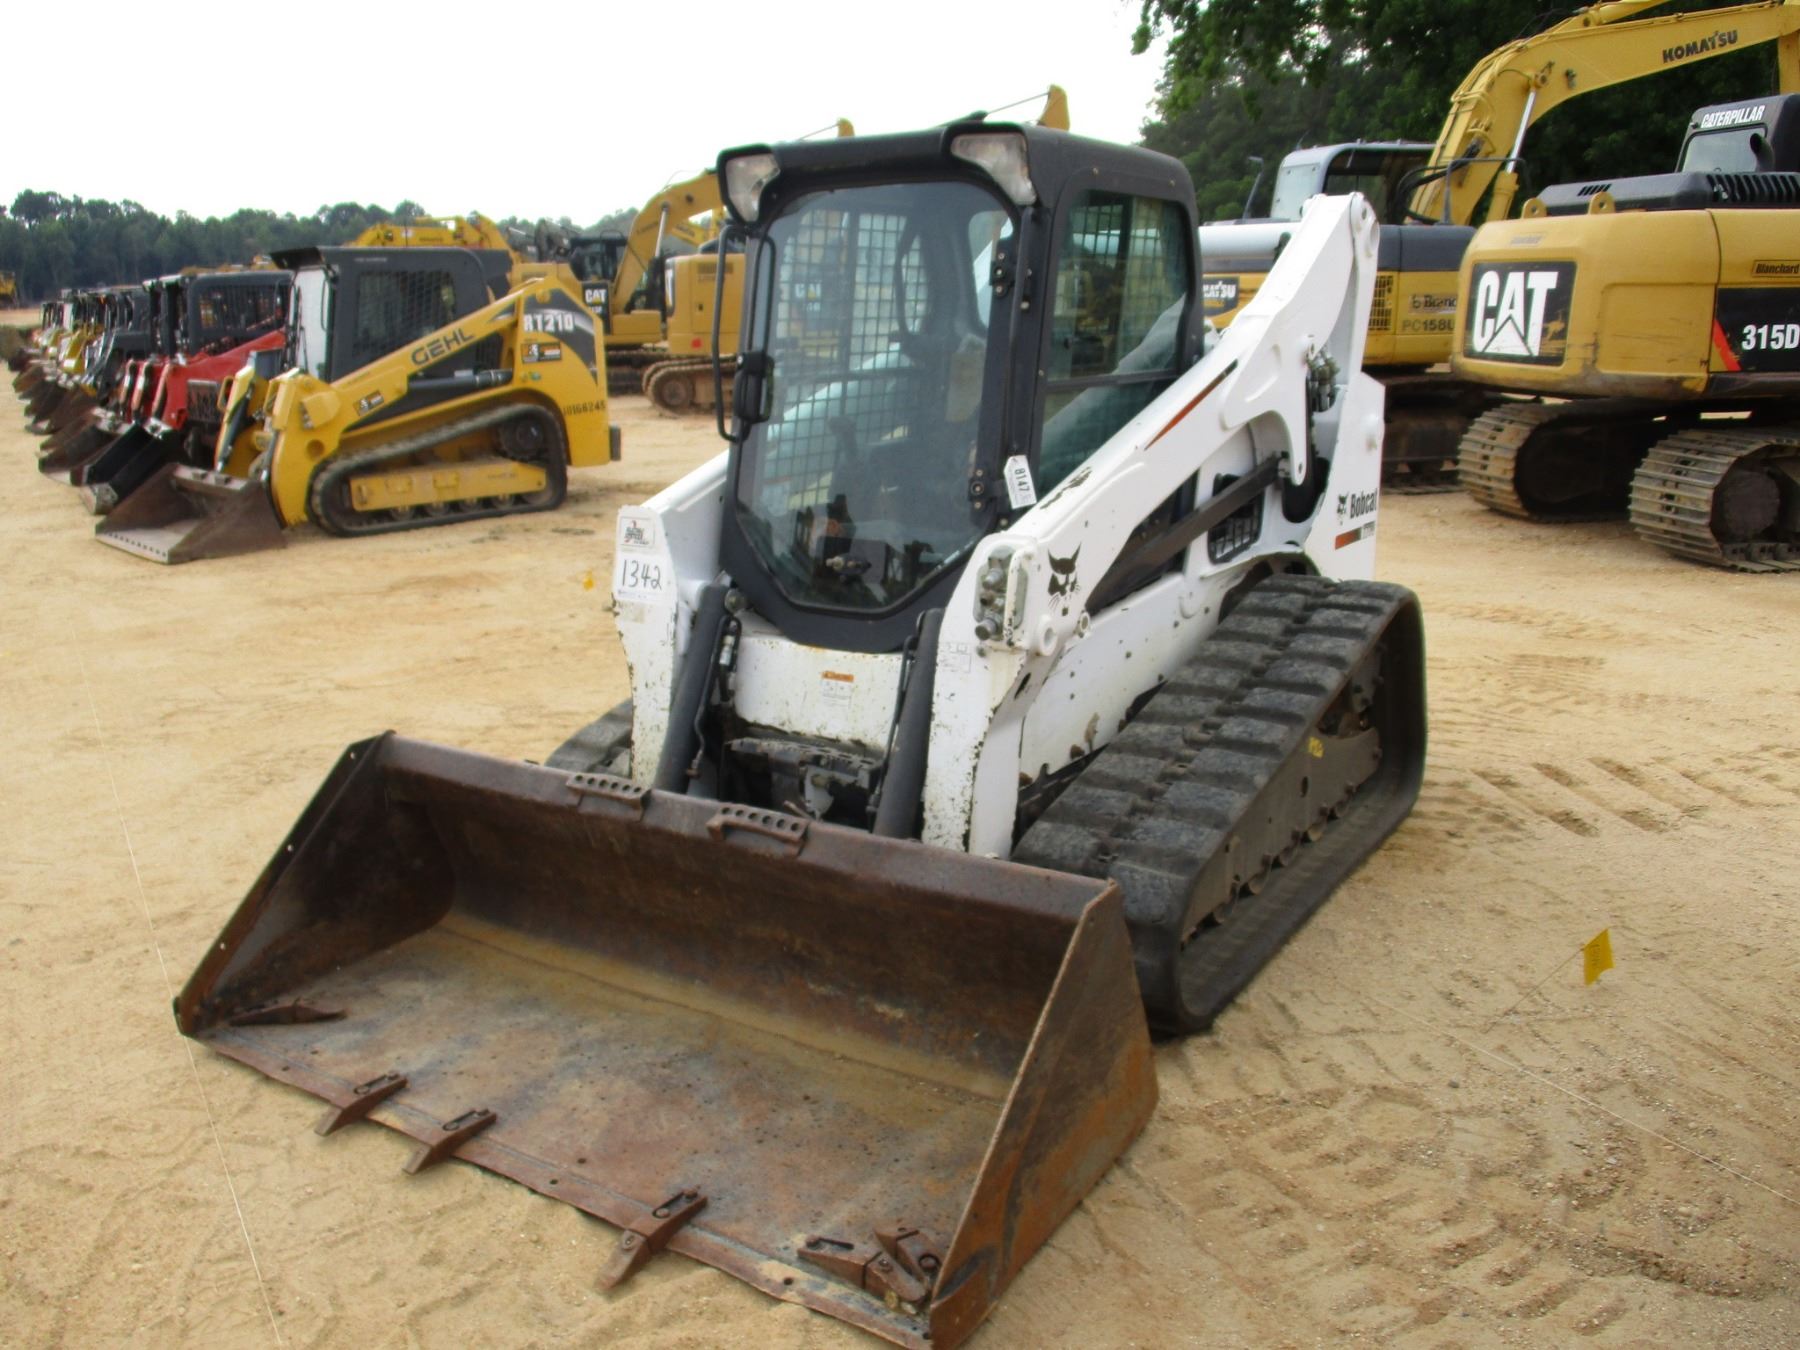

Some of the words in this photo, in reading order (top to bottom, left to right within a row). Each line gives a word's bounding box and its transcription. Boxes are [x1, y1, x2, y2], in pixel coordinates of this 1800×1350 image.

[1662, 29, 1738, 63] KOMATSU
[1701, 104, 1766, 129] CATERPILLAR
[1756, 263, 1800, 274] Blanchard
[585, 288, 607, 303] CAT
[523, 312, 575, 332] RT210
[1472, 270, 1559, 357] CAT
[411, 328, 476, 366] GEHL
[1741, 324, 1800, 350] 315D
[1014, 467, 1030, 492] 8147
[1350, 487, 1378, 519] Bobcat
[622, 559, 662, 590] 1342
